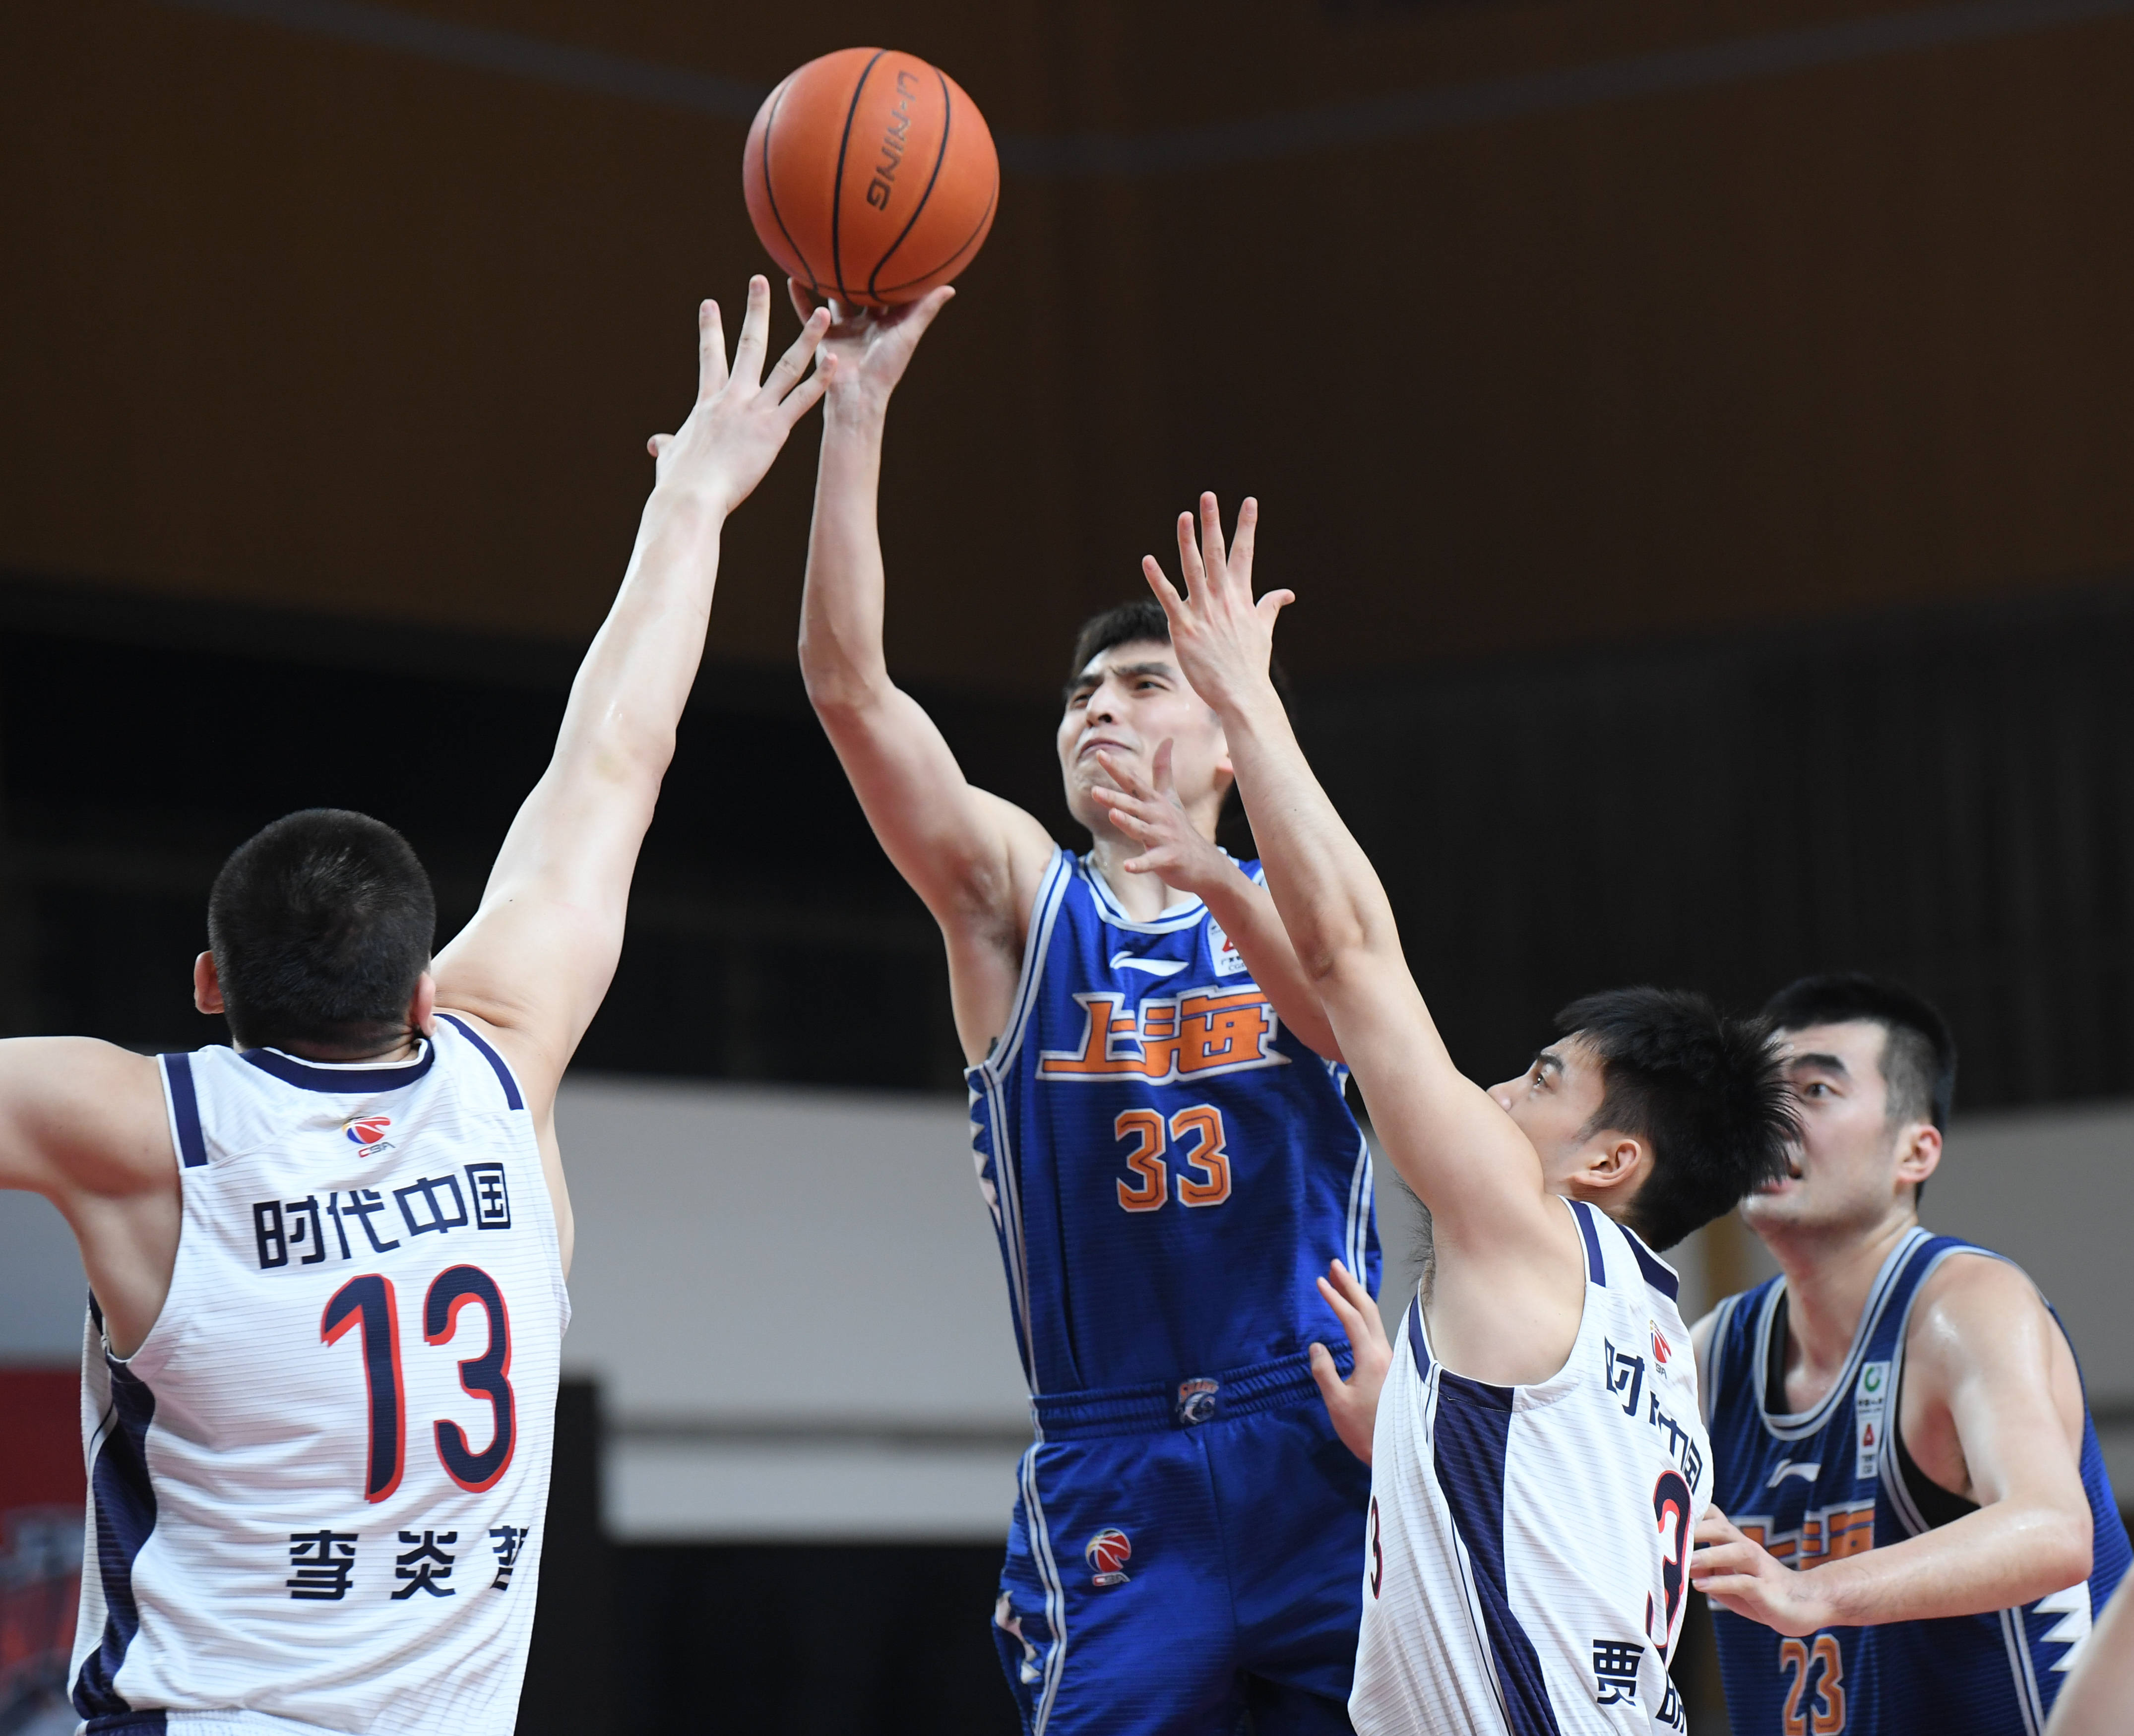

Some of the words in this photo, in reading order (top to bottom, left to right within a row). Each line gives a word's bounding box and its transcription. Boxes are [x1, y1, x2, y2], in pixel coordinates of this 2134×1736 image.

[866, 69, 919, 212] LI-NING
[1035, 984, 1292, 1086] 上海
[359, 1142, 396, 1158] CBA
[1114, 1104, 1232, 1212] 33
[253, 1163, 511, 1270] 时代中国
[320, 1264, 516, 1504] 13
[1646, 1470, 1691, 1669] 3
[1779, 1633, 1846, 1736] 23
